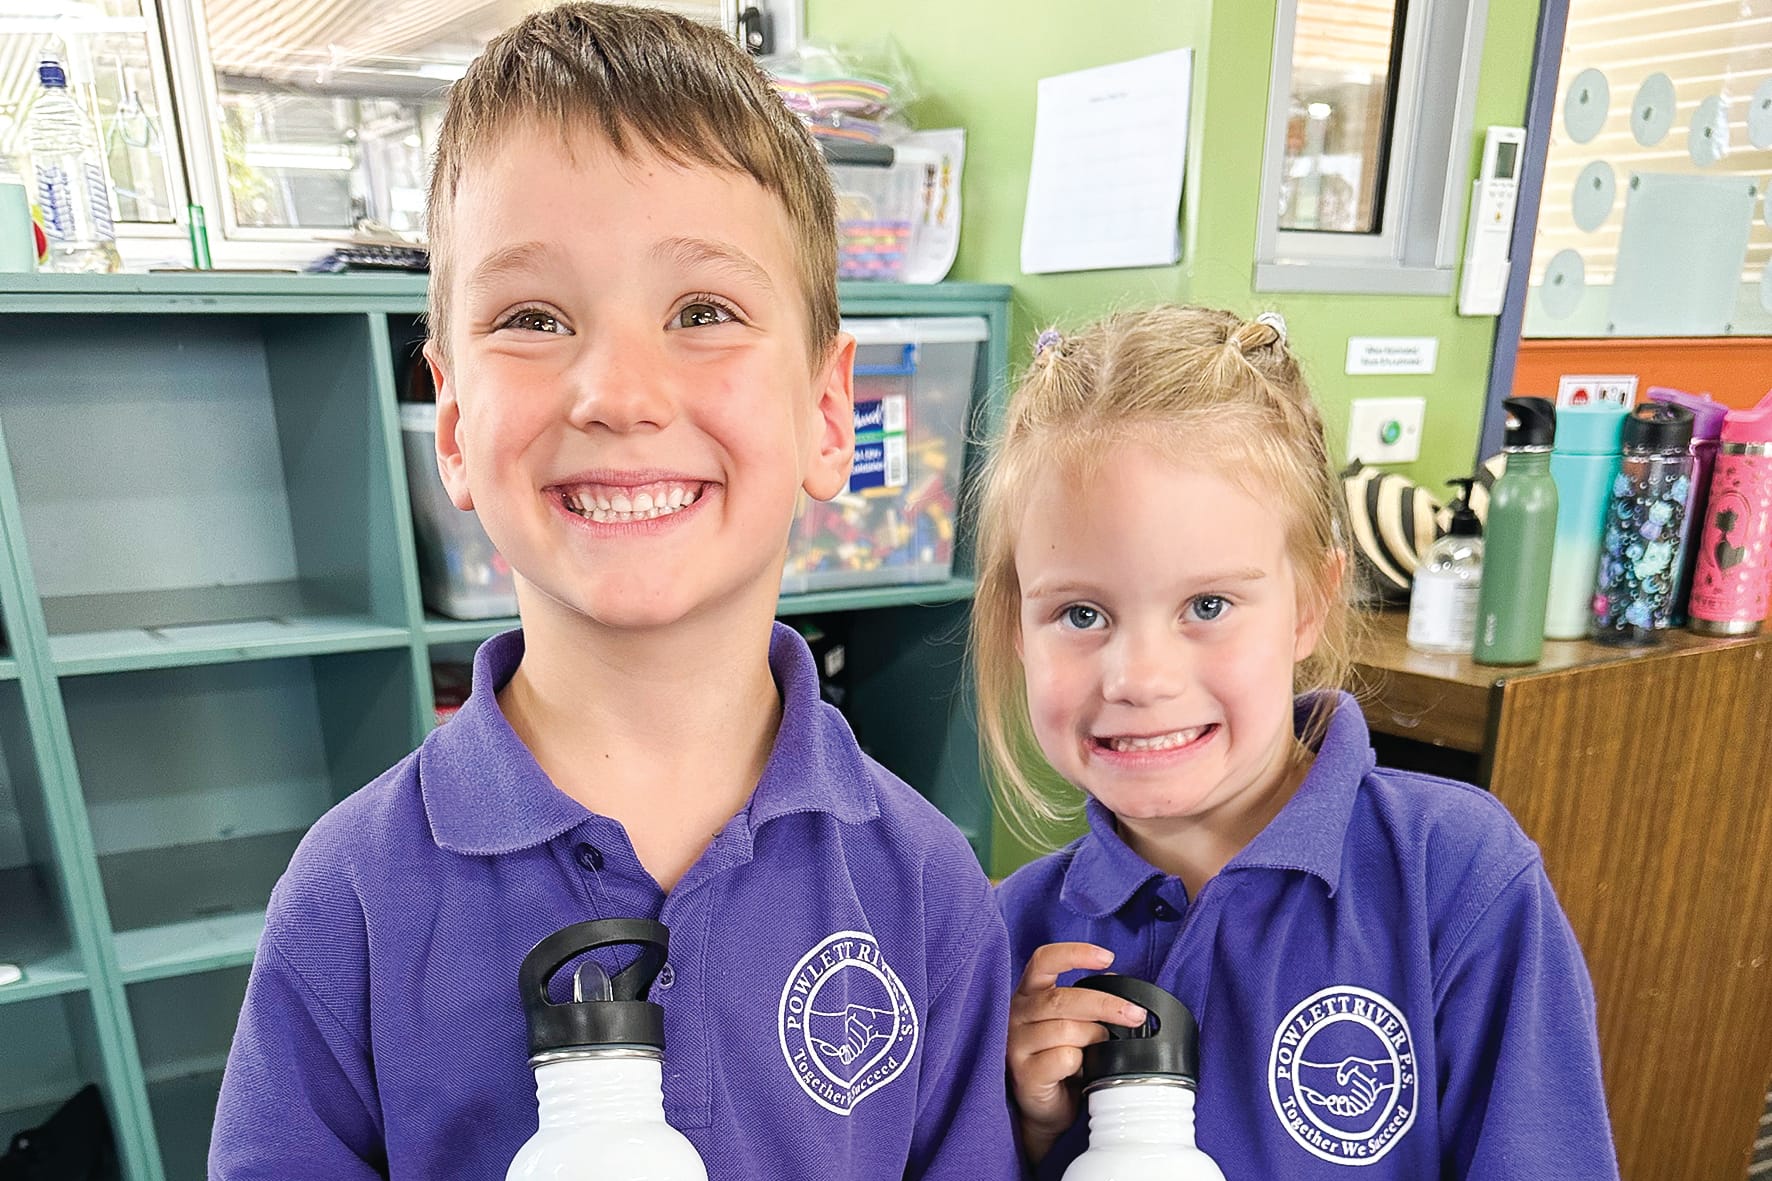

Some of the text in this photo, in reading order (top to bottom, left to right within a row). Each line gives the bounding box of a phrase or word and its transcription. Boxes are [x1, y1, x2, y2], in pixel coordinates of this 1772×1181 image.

[787, 941, 854, 1030] POWLETT
[1277, 996, 1350, 1080] POWLETT
[1353, 997, 1407, 1050] RIVER
[793, 1048, 848, 1105] Together
[1282, 1095, 1409, 1157] Together We Succeed
